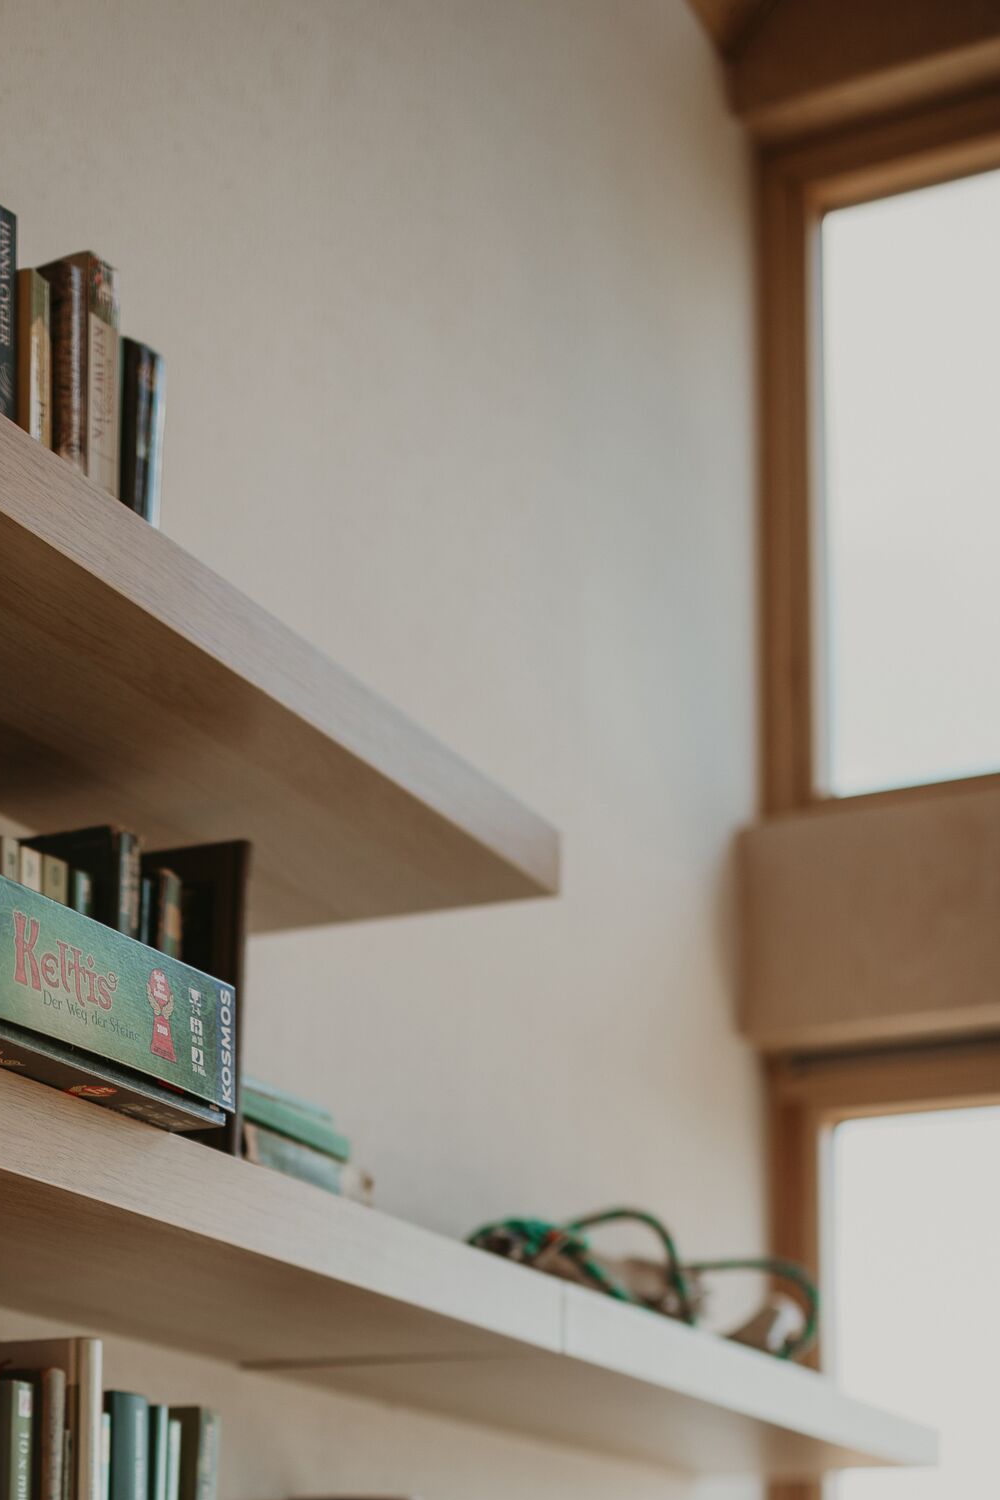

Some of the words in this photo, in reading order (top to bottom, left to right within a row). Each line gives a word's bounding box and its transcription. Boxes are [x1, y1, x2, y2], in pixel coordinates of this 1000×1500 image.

[13, 910, 119, 1011] Keltis
[43, 990, 62, 1010] Der
[66, 999, 88, 1025] Weg
[92, 1010, 107, 1028] der
[110, 1017, 140, 1041] Steine
[220, 988, 232, 1104] KOSMOS
[19, 1433, 30, 1453] 10
